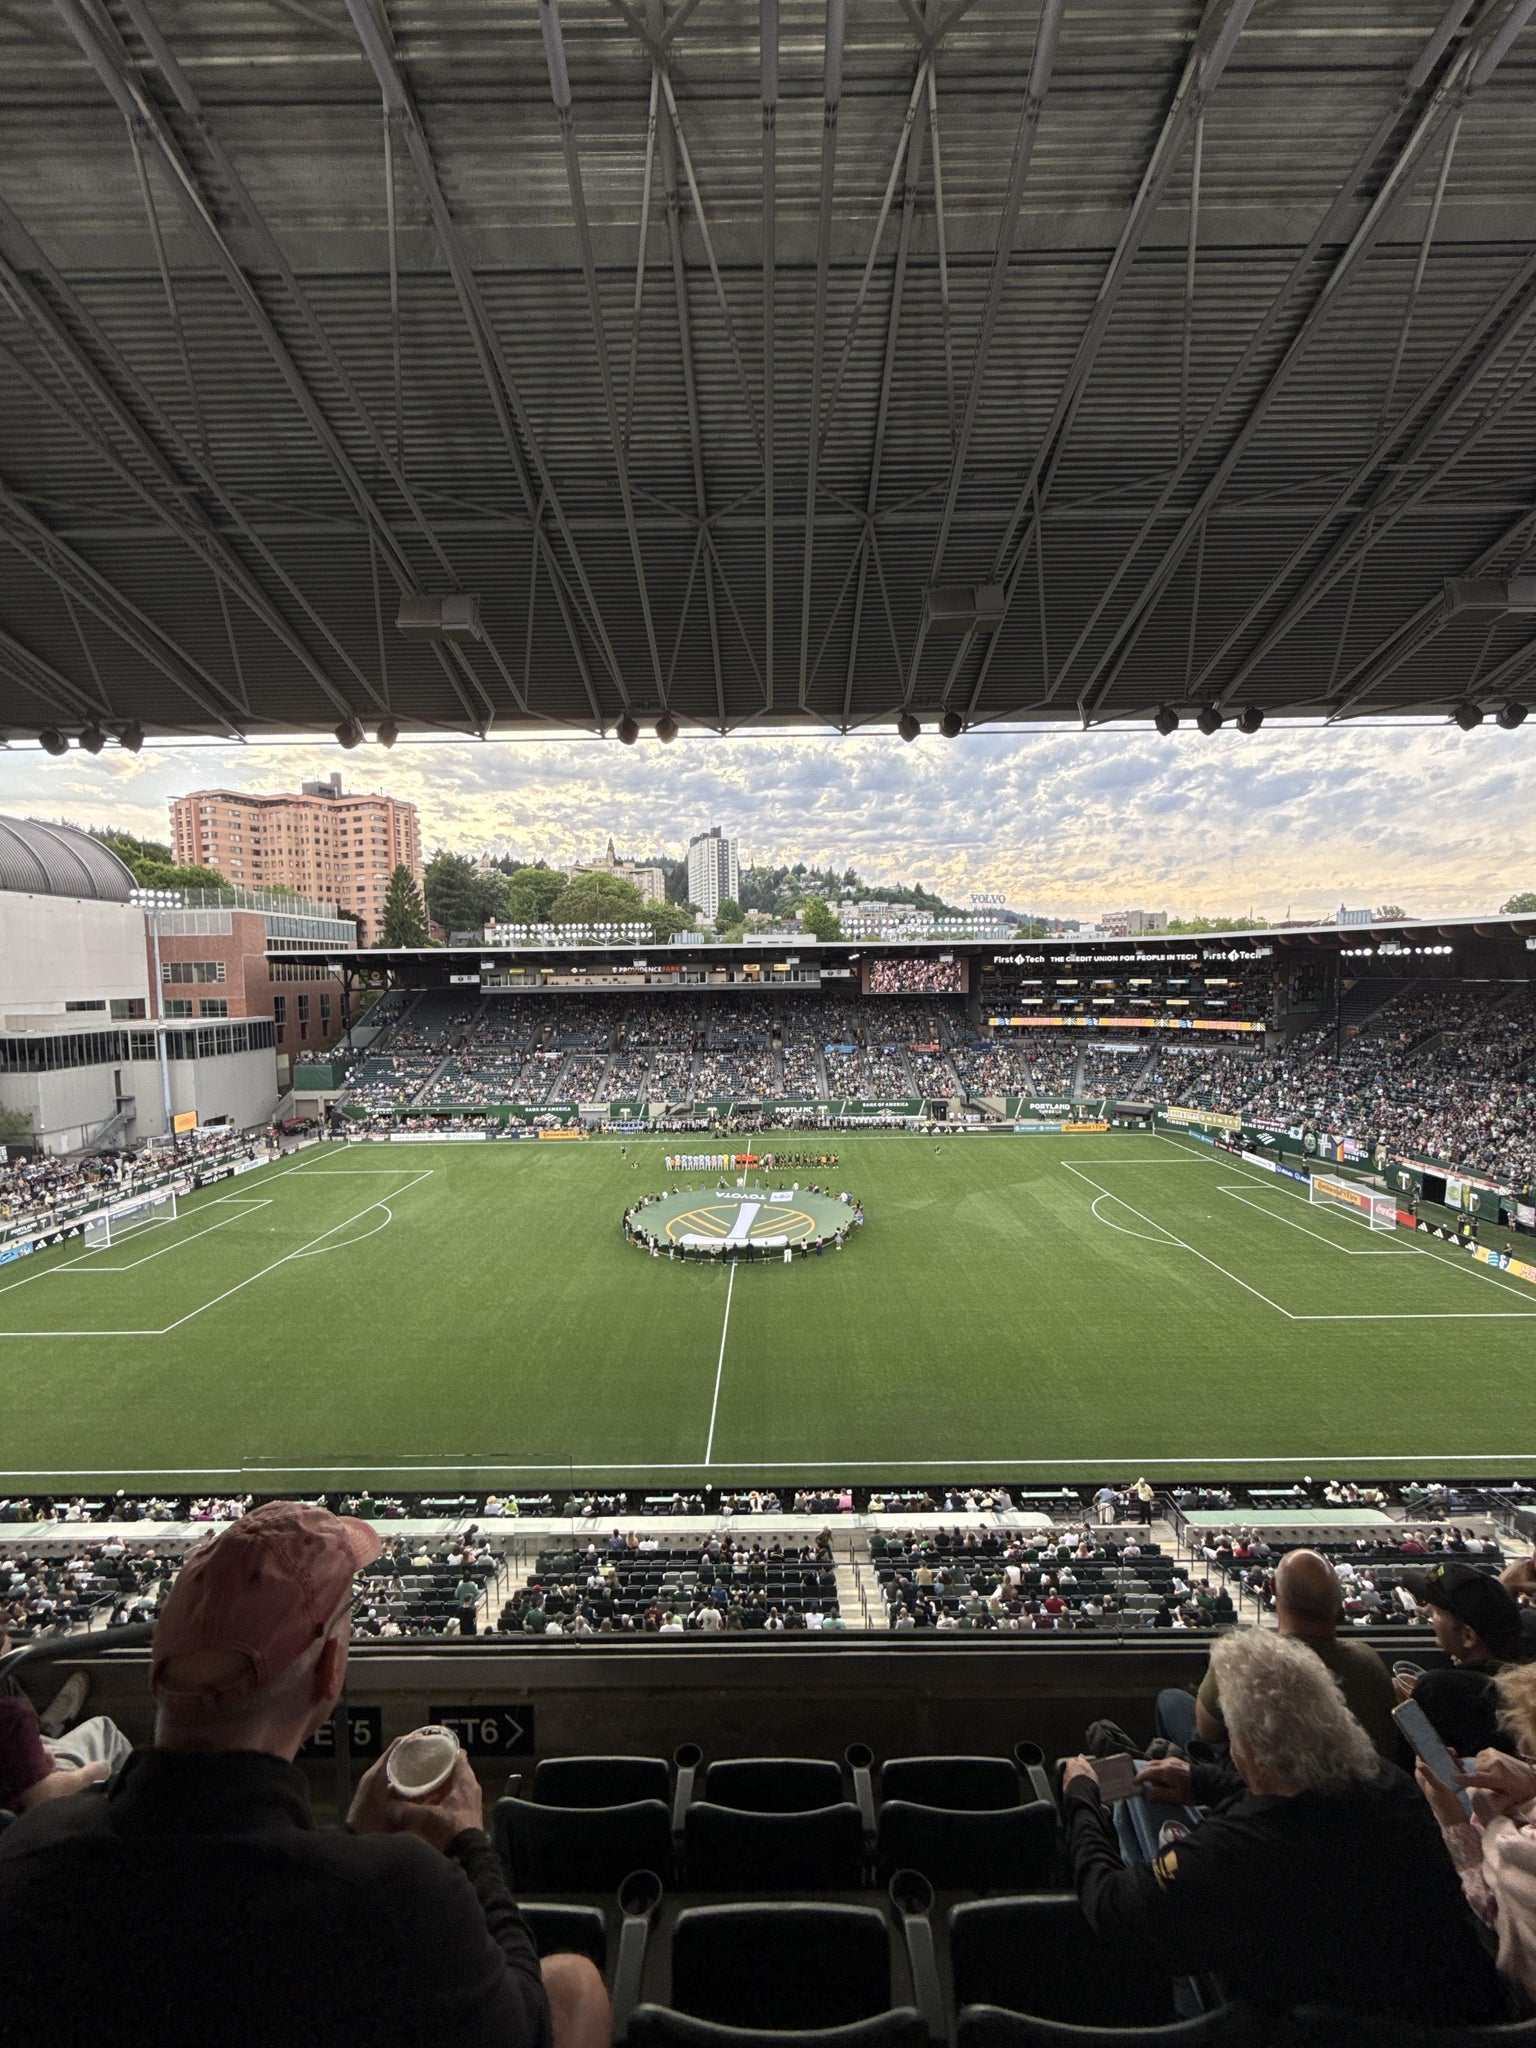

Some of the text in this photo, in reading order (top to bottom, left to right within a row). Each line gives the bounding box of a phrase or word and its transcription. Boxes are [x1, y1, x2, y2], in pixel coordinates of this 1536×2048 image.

[970, 894, 1006, 904] VOLVO
[993, 955, 1045, 964] First Tech
[1065, 955, 1092, 963] CEDIT
[1119, 954, 1135, 962] FOR
[1136, 953, 1166, 961] PEOPLE
[1166, 953, 1175, 961] IN
[1176, 953, 1197, 961] TECH
[1241, 1121, 1257, 1129] BANK
[1265, 1126, 1291, 1136] AMERICA
[715, 1191, 767, 1200] TOYOTA
[314, 1719, 372, 1746] E5
